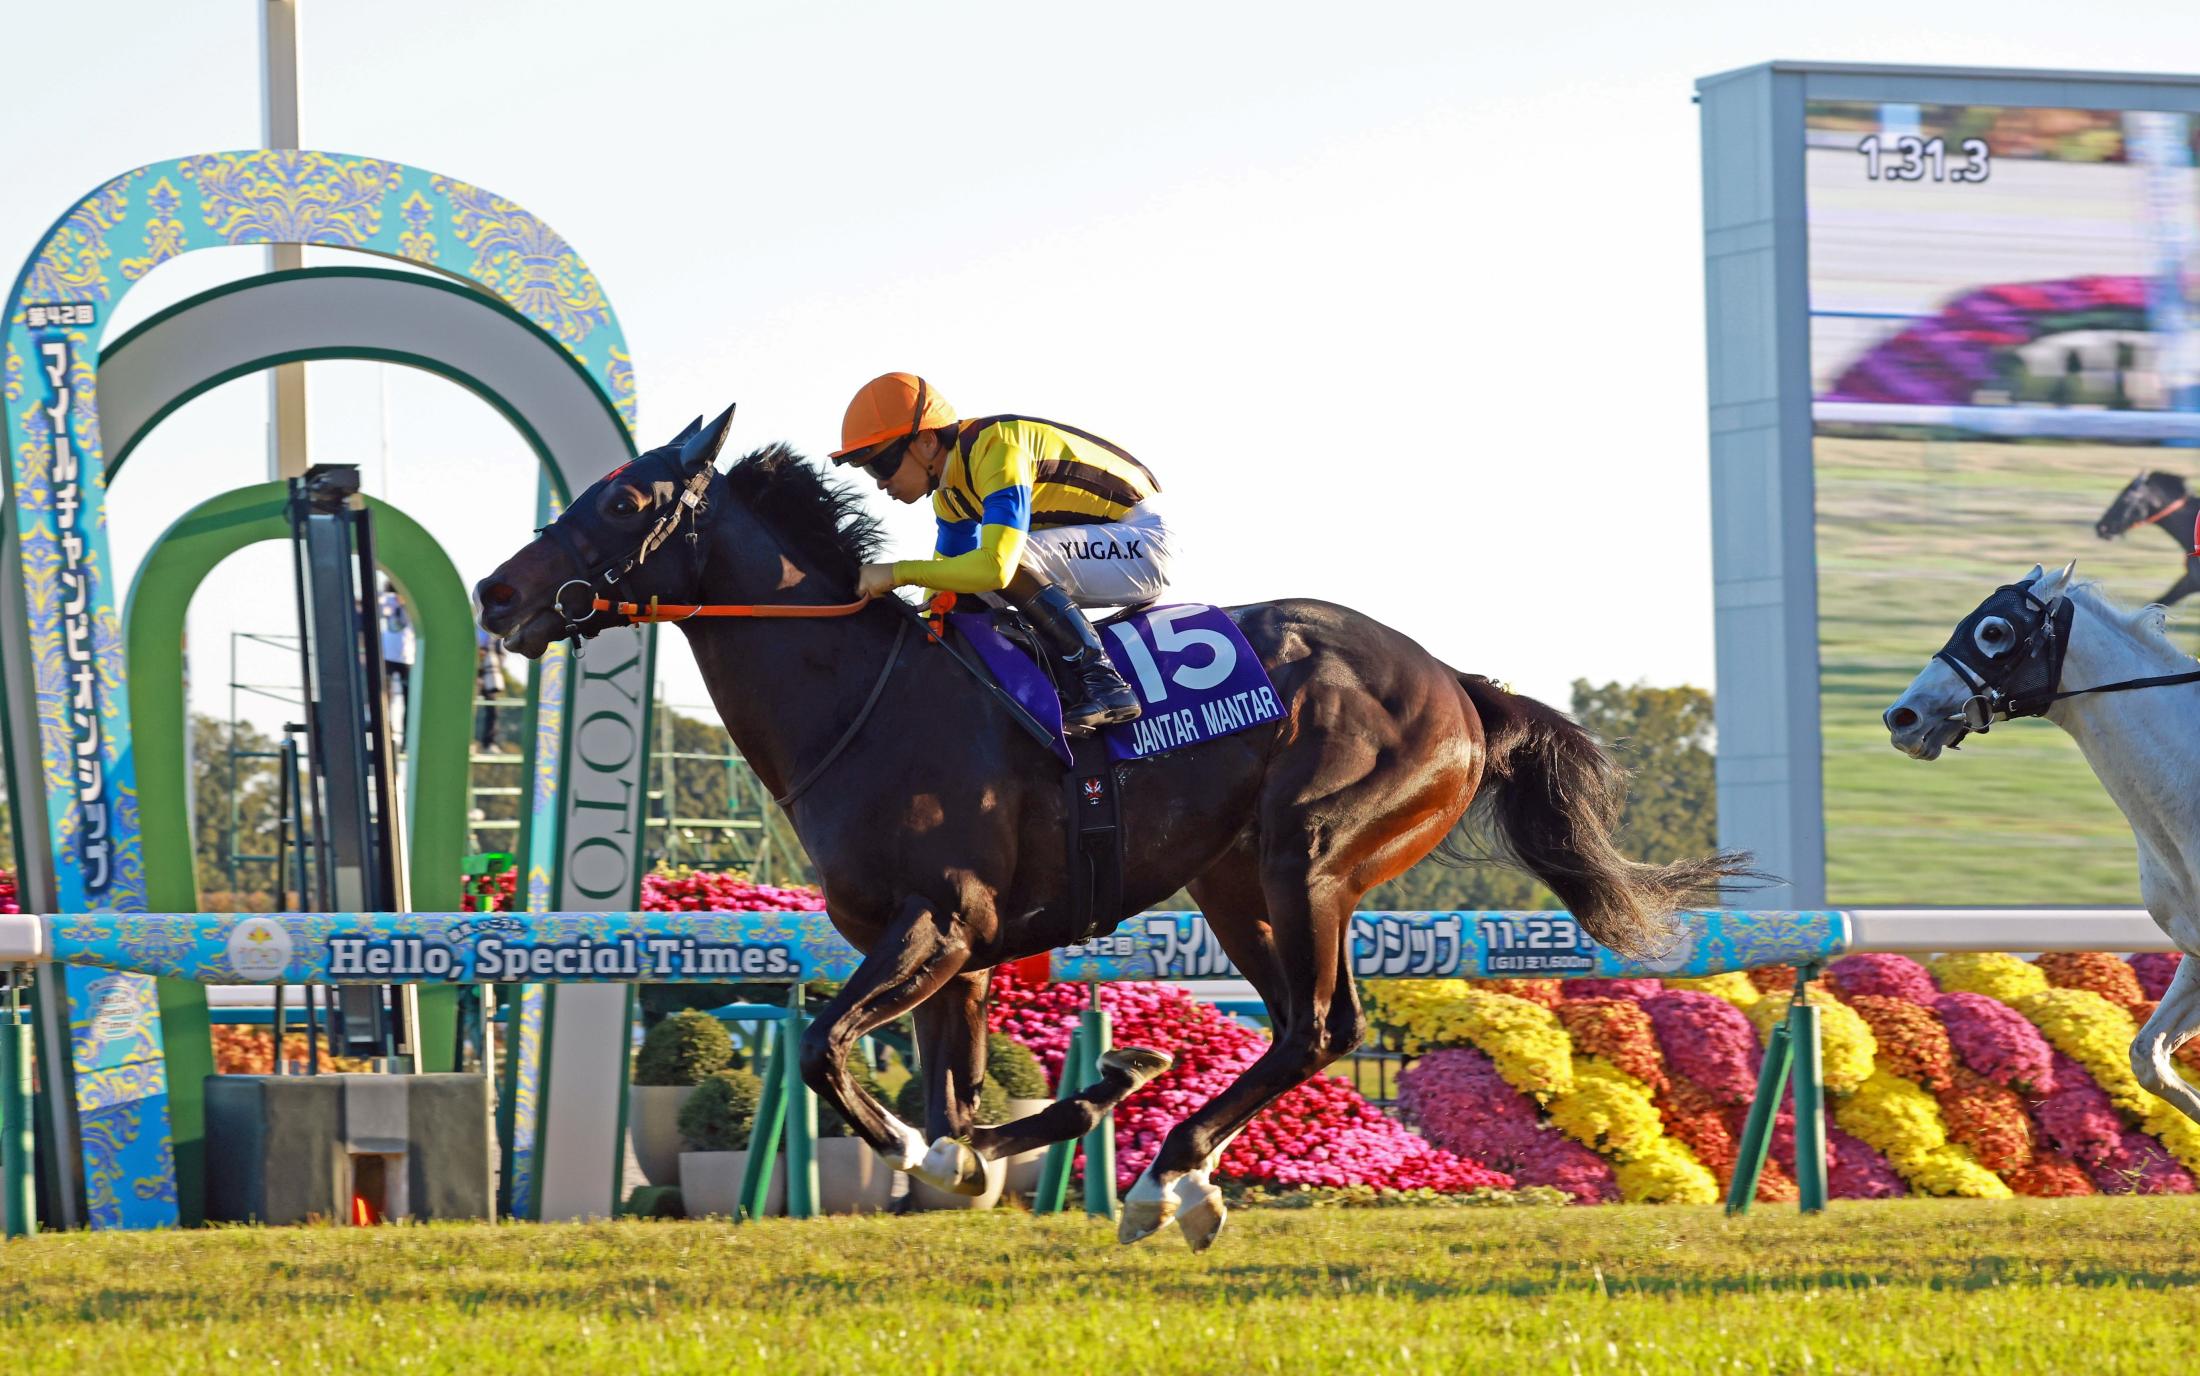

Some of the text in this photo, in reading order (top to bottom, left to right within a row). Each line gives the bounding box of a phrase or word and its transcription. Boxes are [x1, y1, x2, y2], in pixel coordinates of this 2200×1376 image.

[1858, 134, 1990, 183] 1.31.3
[1059, 540, 1144, 560] YUGA.K
[41, 342, 110, 889] マイルチャンピオンシップ
[1107, 604, 1237, 704] 15
[1132, 685, 1280, 756] JANTAR MANTAR
[567, 630, 642, 900] YOTO
[328, 938, 800, 981] Hello, Special Times.
[1146, 915, 1462, 977] マイル ンシップ
[1481, 921, 1578, 949] 11.23
